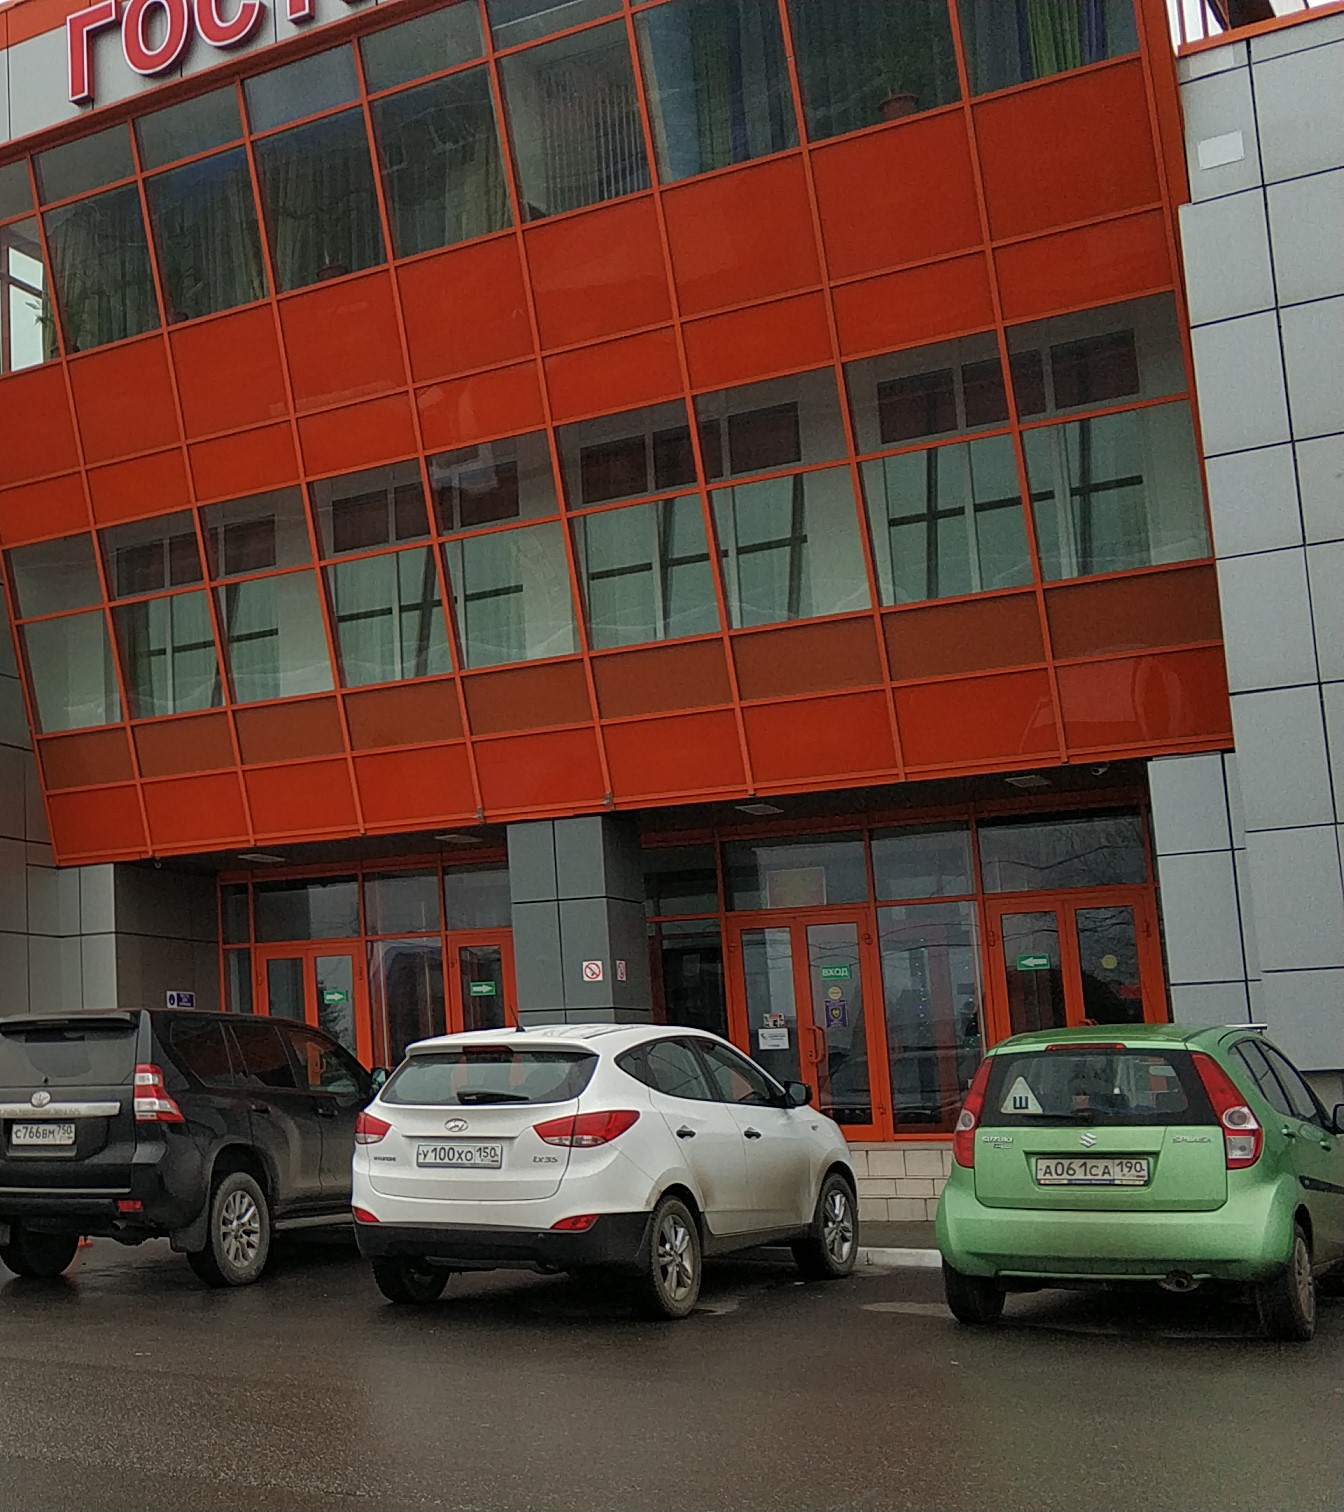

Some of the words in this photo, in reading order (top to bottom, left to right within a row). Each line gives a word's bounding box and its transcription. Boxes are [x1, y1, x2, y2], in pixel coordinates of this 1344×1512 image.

[67, 0, 316, 103] ГОС
[821, 967, 849, 977] ВХОД
[1012, 1095, 1029, 1110] Ш
[15, 1126, 55, 1139] С766ВМ
[56, 1125, 72, 1136] 750
[981, 1135, 1013, 1143] SUZUKI
[422, 1146, 474, 1162] У100ХО
[475, 1147, 496, 1159] 150
[1042, 1161, 1112, 1177] А061СА
[1116, 1160, 1143, 1174] 190
